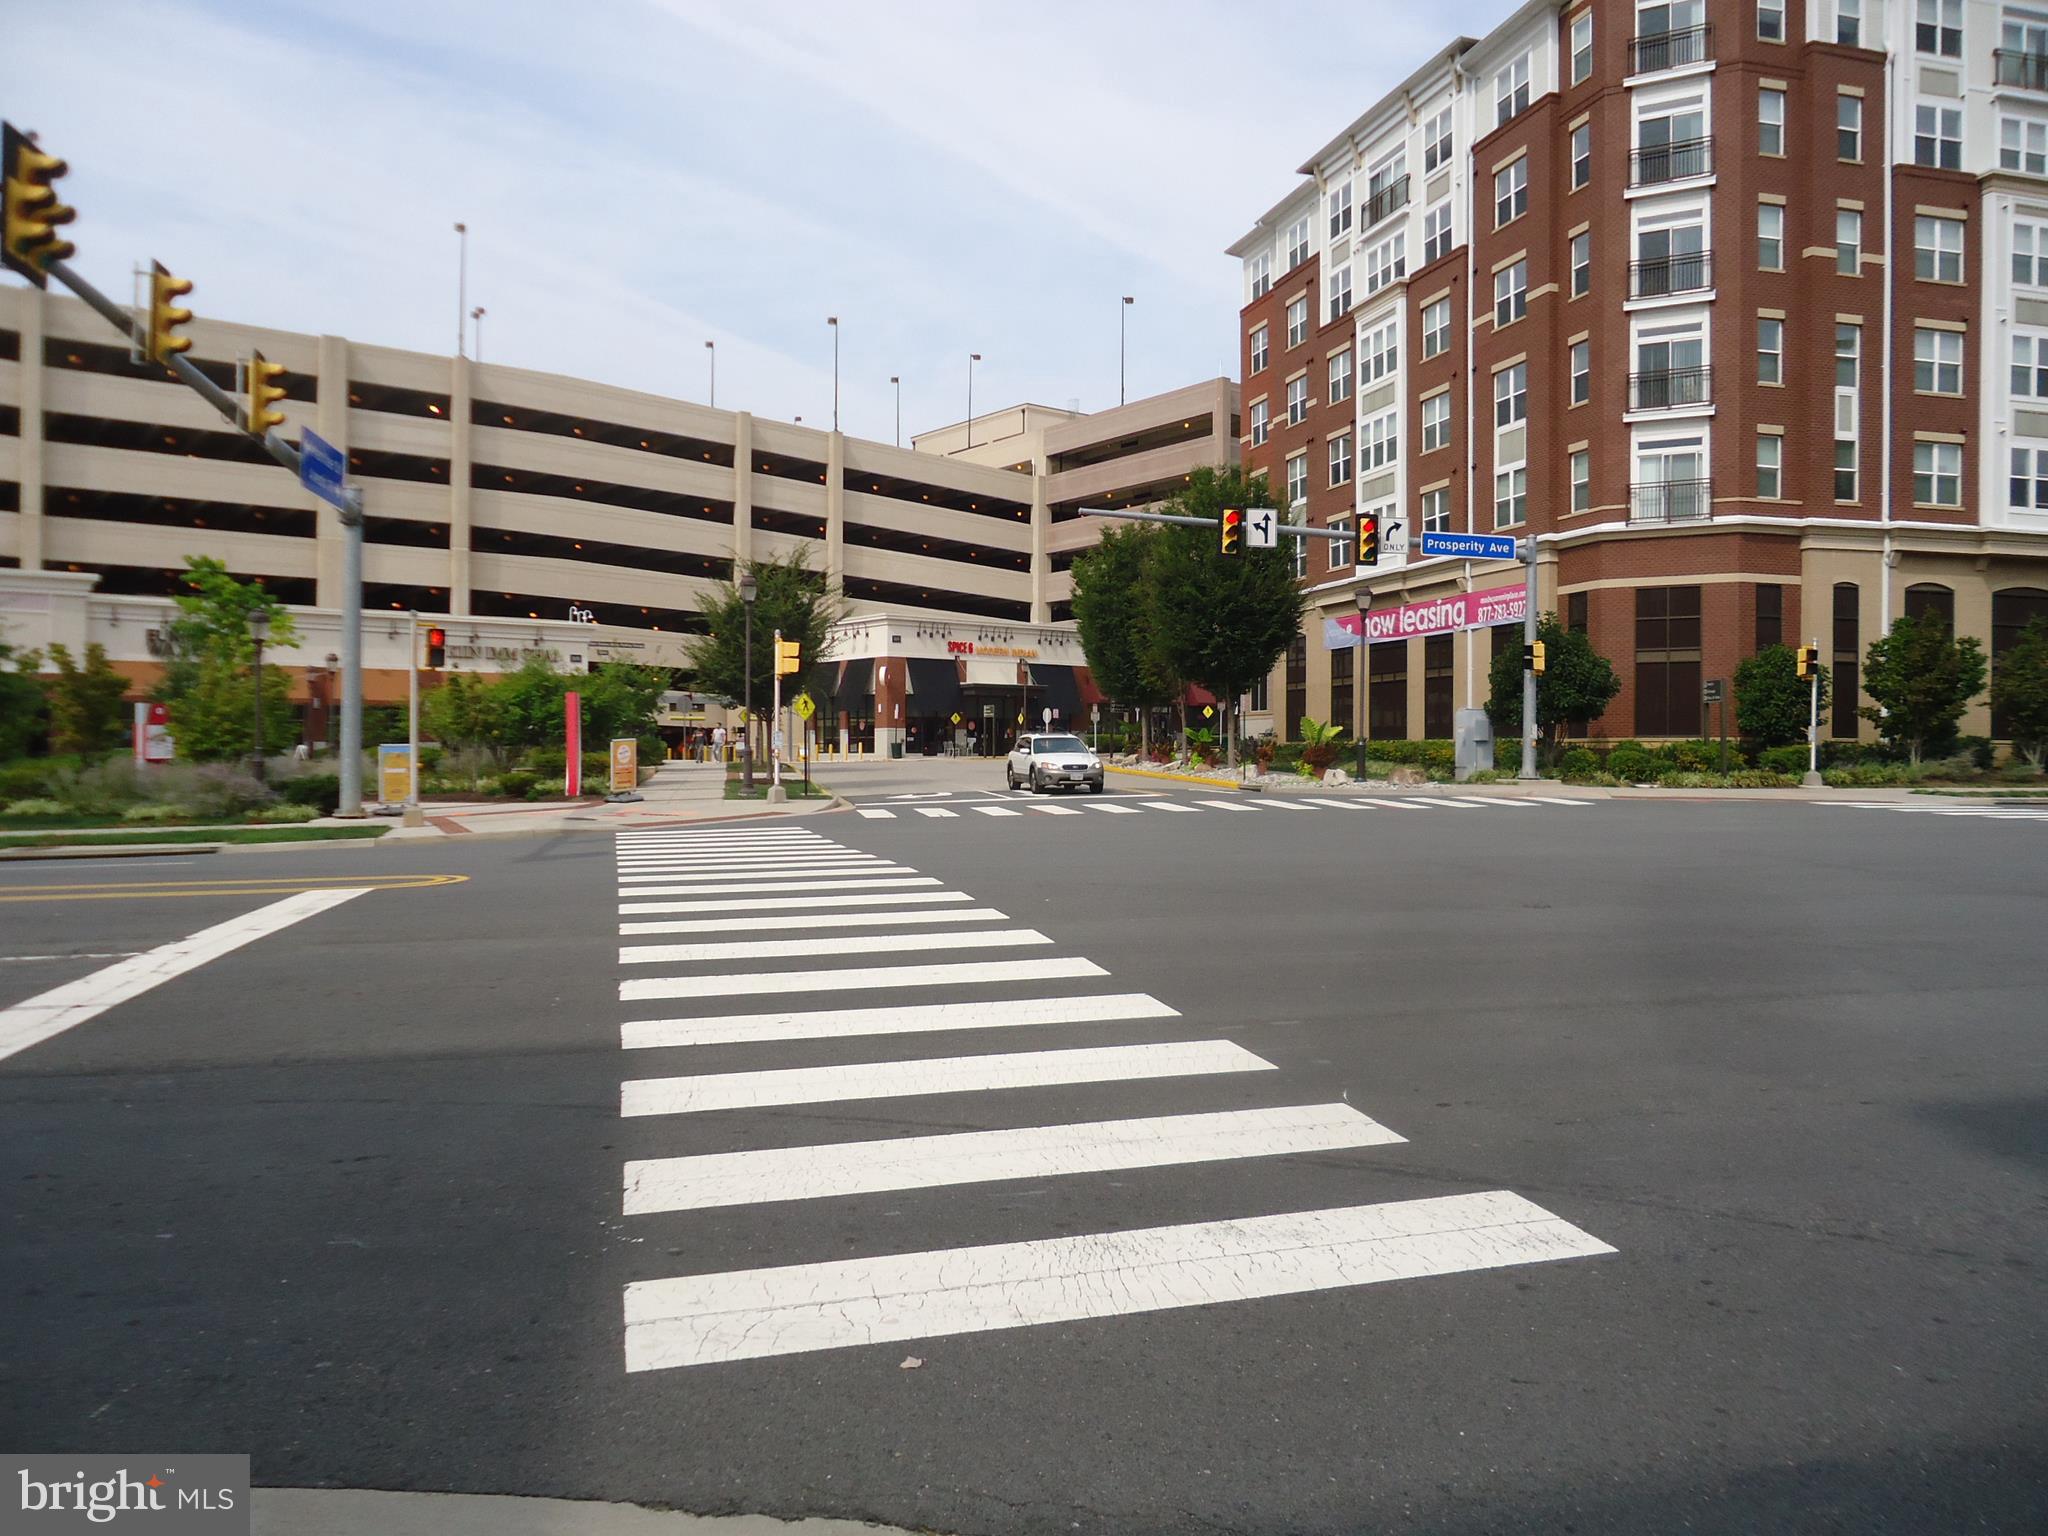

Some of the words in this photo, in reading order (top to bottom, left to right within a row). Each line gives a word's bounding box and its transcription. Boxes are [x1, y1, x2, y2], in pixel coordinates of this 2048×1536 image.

[1383, 543, 1405, 551] ONLY
[1427, 538, 1485, 554] Prosperity
[1489, 541, 1510, 553] Ave
[1399, 599, 1466, 633] leasing
[947, 640, 967, 654] SPICE
